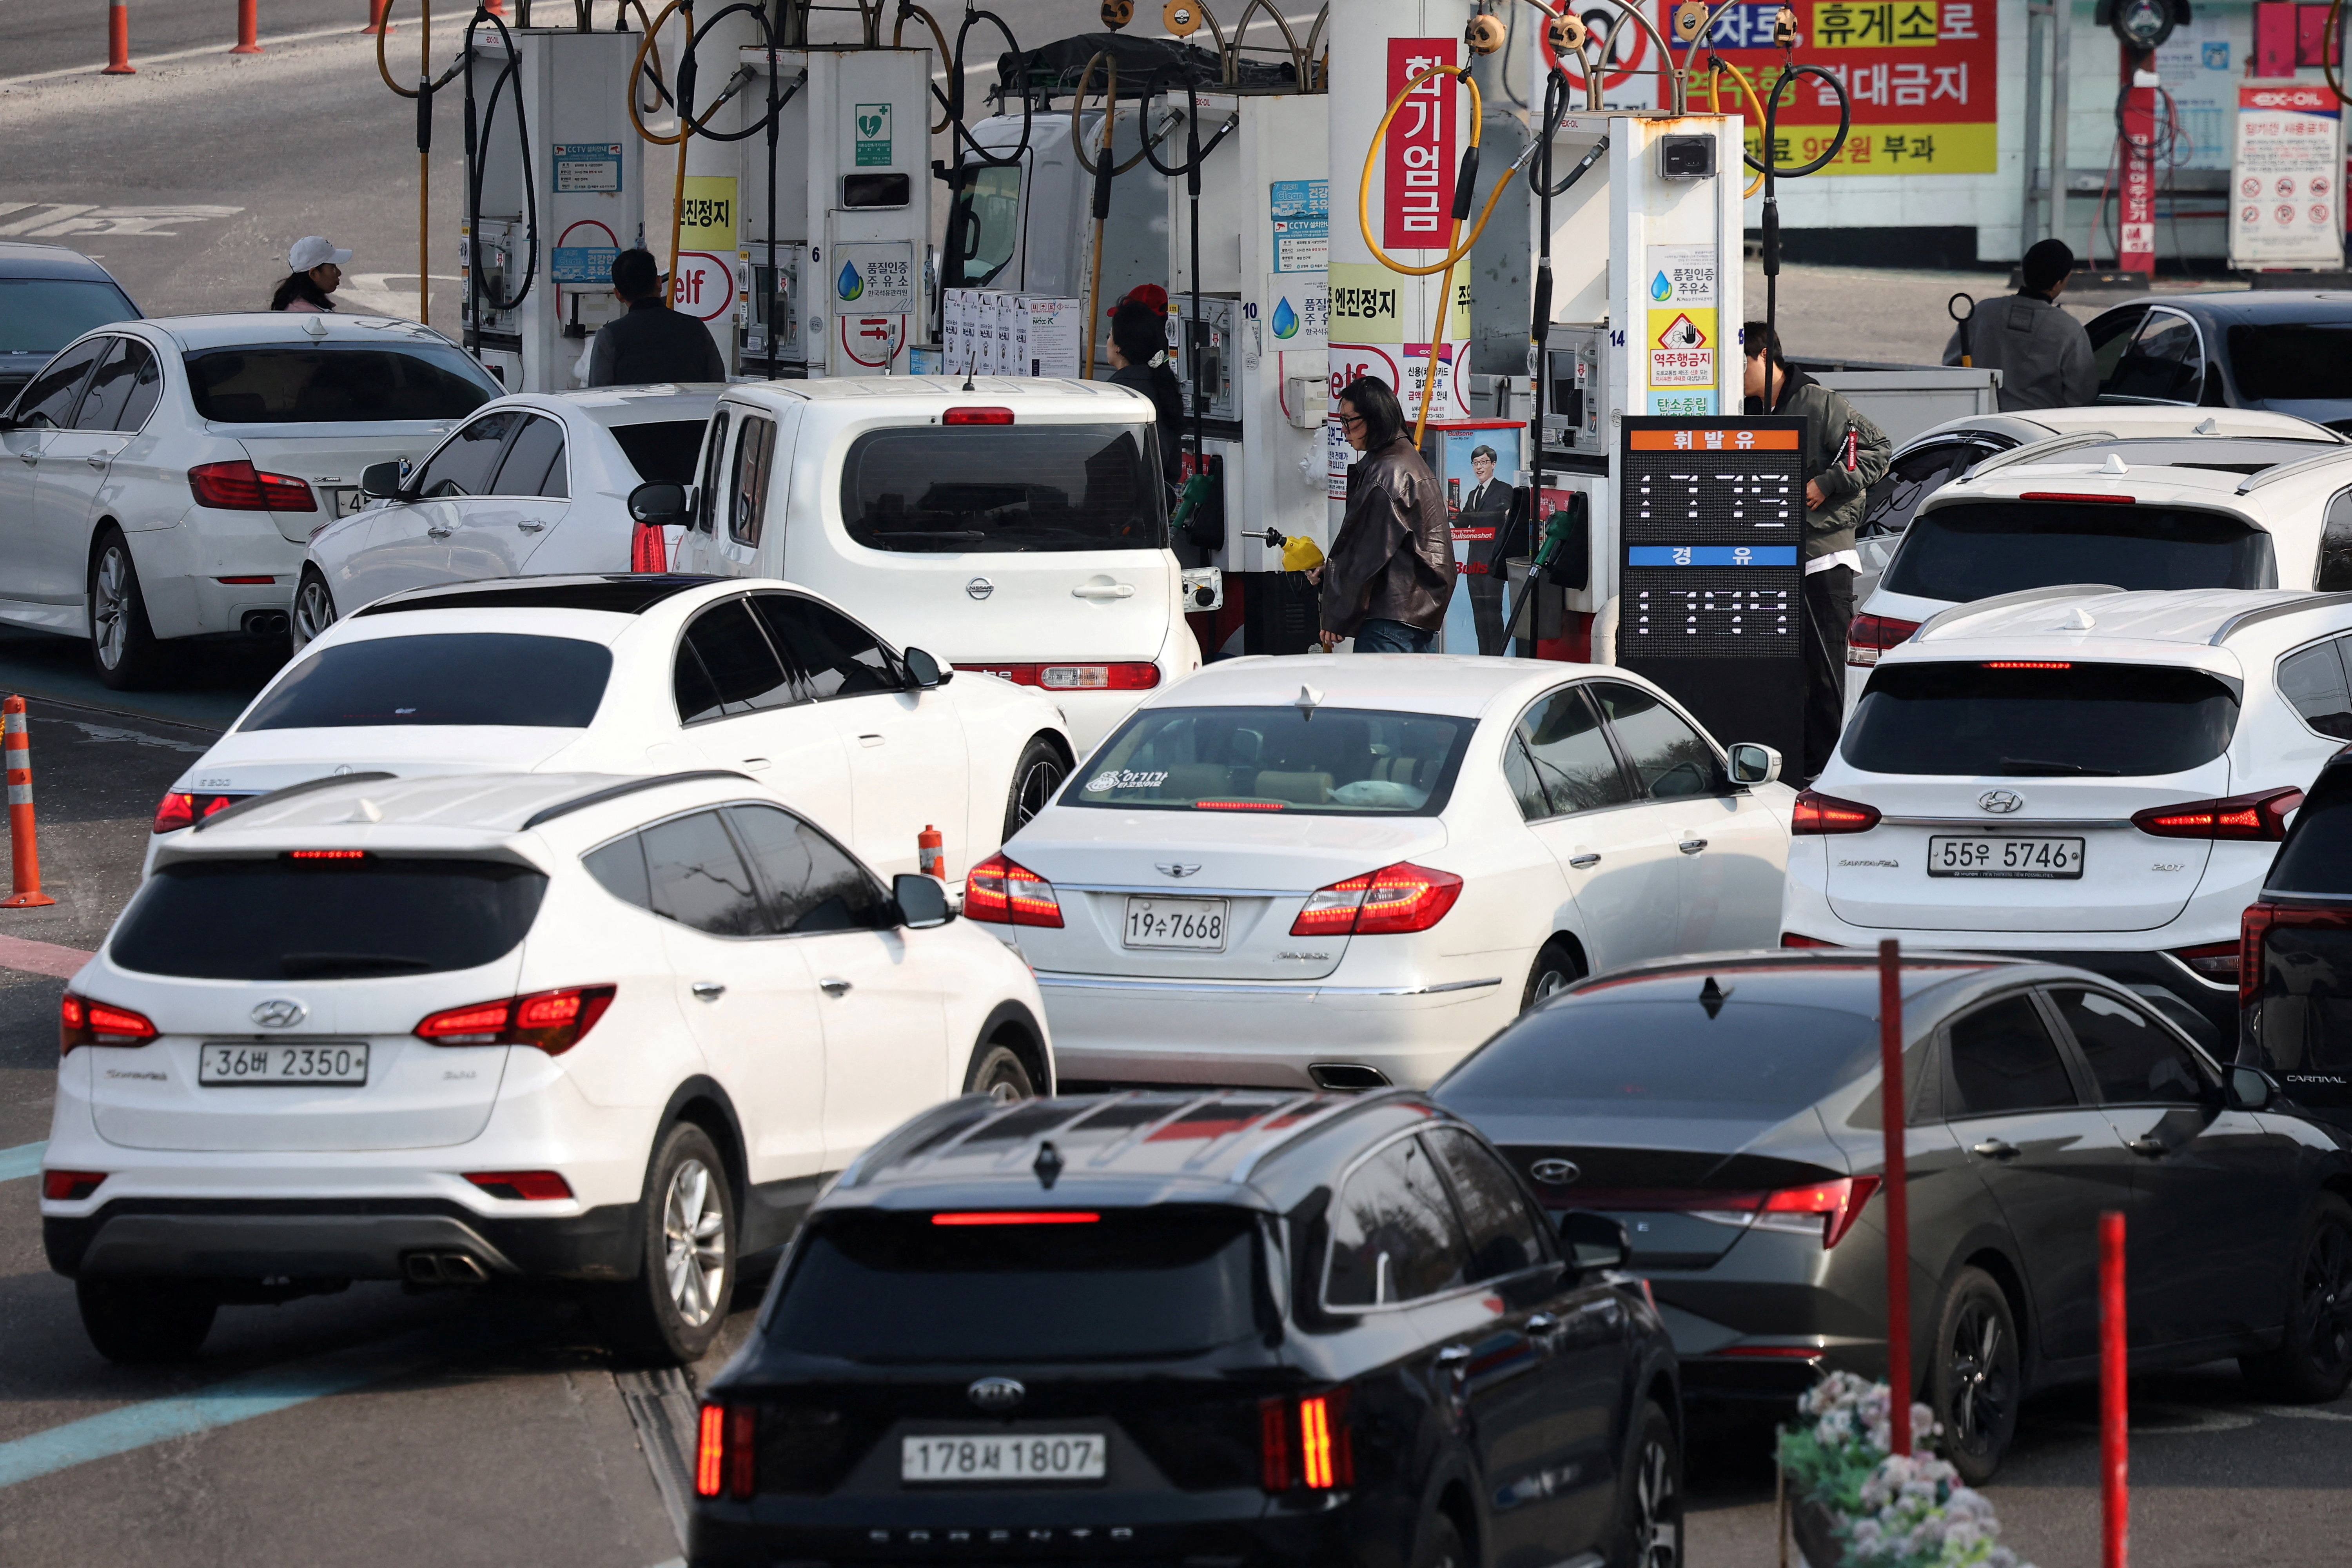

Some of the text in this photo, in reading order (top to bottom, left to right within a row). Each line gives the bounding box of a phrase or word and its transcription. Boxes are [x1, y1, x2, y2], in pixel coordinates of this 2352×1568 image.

[1817, 2, 1979, 45] 휴게소로
[1812, 62, 1969, 107] 절대금지
[1402, 56, 1445, 232] 화기엄금
[1883, 135, 1936, 163] 부과
[1277, 191, 1304, 200] Clean
[1308, 188, 1328, 198] 건강
[1308, 200, 1328, 210] 주유
[812, 247, 820, 262] 6
[867, 262, 908, 274] 품질인증
[1673, 269, 1715, 281] 품질인증
[675, 269, 706, 305] elf
[1679, 283, 1709, 294] 주유소
[1243, 302, 1257, 319] 10
[1304, 298, 1327, 311] 품질
[1335, 287, 1396, 319] 엔진정지
[1610, 330, 1625, 347] 14
[1654, 353, 1710, 367] 역주행금지
[1437, 391, 1447, 401] 안내
[1657, 397, 1707, 412] 탄소중립
[1943, 842, 2067, 869] 55우 5746
[283, 1051, 350, 1076] 2350
[2287, 1074, 2346, 1083] CARNIVAL
